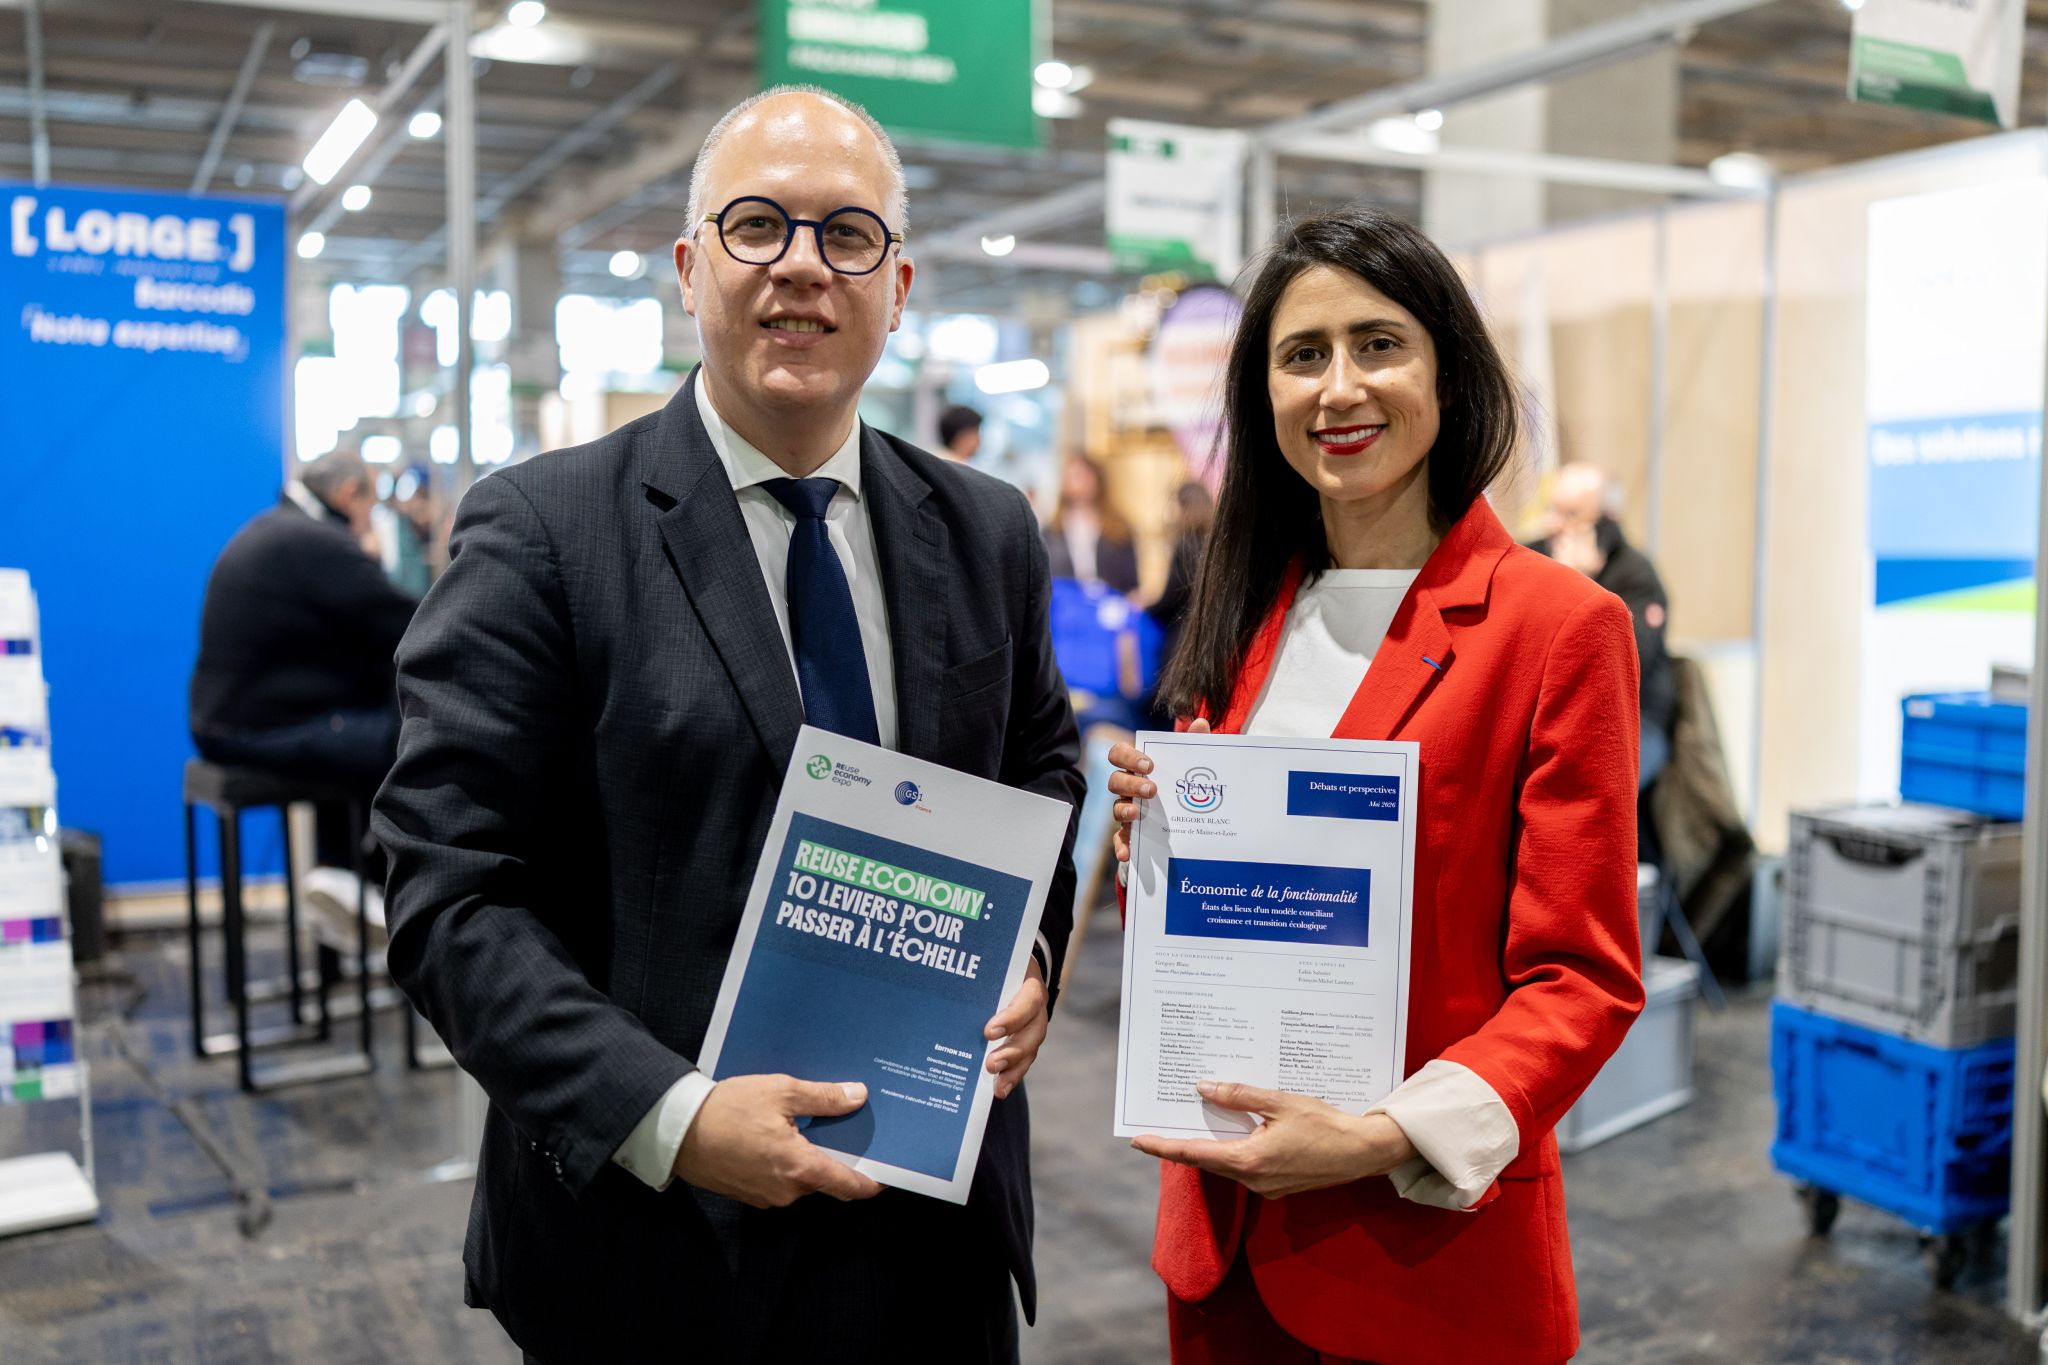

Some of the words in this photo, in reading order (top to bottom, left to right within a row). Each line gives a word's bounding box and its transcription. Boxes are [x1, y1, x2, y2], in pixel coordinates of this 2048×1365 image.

[836, 763, 860, 774] REuse
[832, 776, 852, 787] expo
[834, 769, 872, 786] economy
[905, 789, 923, 802] GS1
[1175, 779, 1227, 797] SÉNAT
[1309, 781, 1338, 791] Débats
[1348, 785, 1397, 795] perspectives
[1207, 817, 1230, 825] BLANC
[795, 842, 860, 881] REUSE
[860, 859, 985, 917] ECONOMY
[1180, 877, 1248, 897] Économie
[1250, 885, 1265, 898] de
[1267, 886, 1279, 899] la
[1277, 886, 1358, 904] fonctionnalité
[786, 871, 817, 900] 10
[818, 880, 898, 924] LEVIERS
[899, 904, 964, 943] POUR
[1201, 902, 1220, 911] États
[1221, 904, 1233, 912] des
[1234, 904, 1252, 913] lieux
[1253, 905, 1270, 914] d'un
[1271, 906, 1298, 916] modèle
[1298, 908, 1334, 918] conciliant
[1206, 916, 1244, 925] croissance
[1253, 919, 1288, 928] transition
[1288, 920, 1328, 932] écologique
[776, 901, 854, 944] PASSER
[854, 917, 872, 949] À
[873, 926, 981, 979] L'ÉCHELLE
